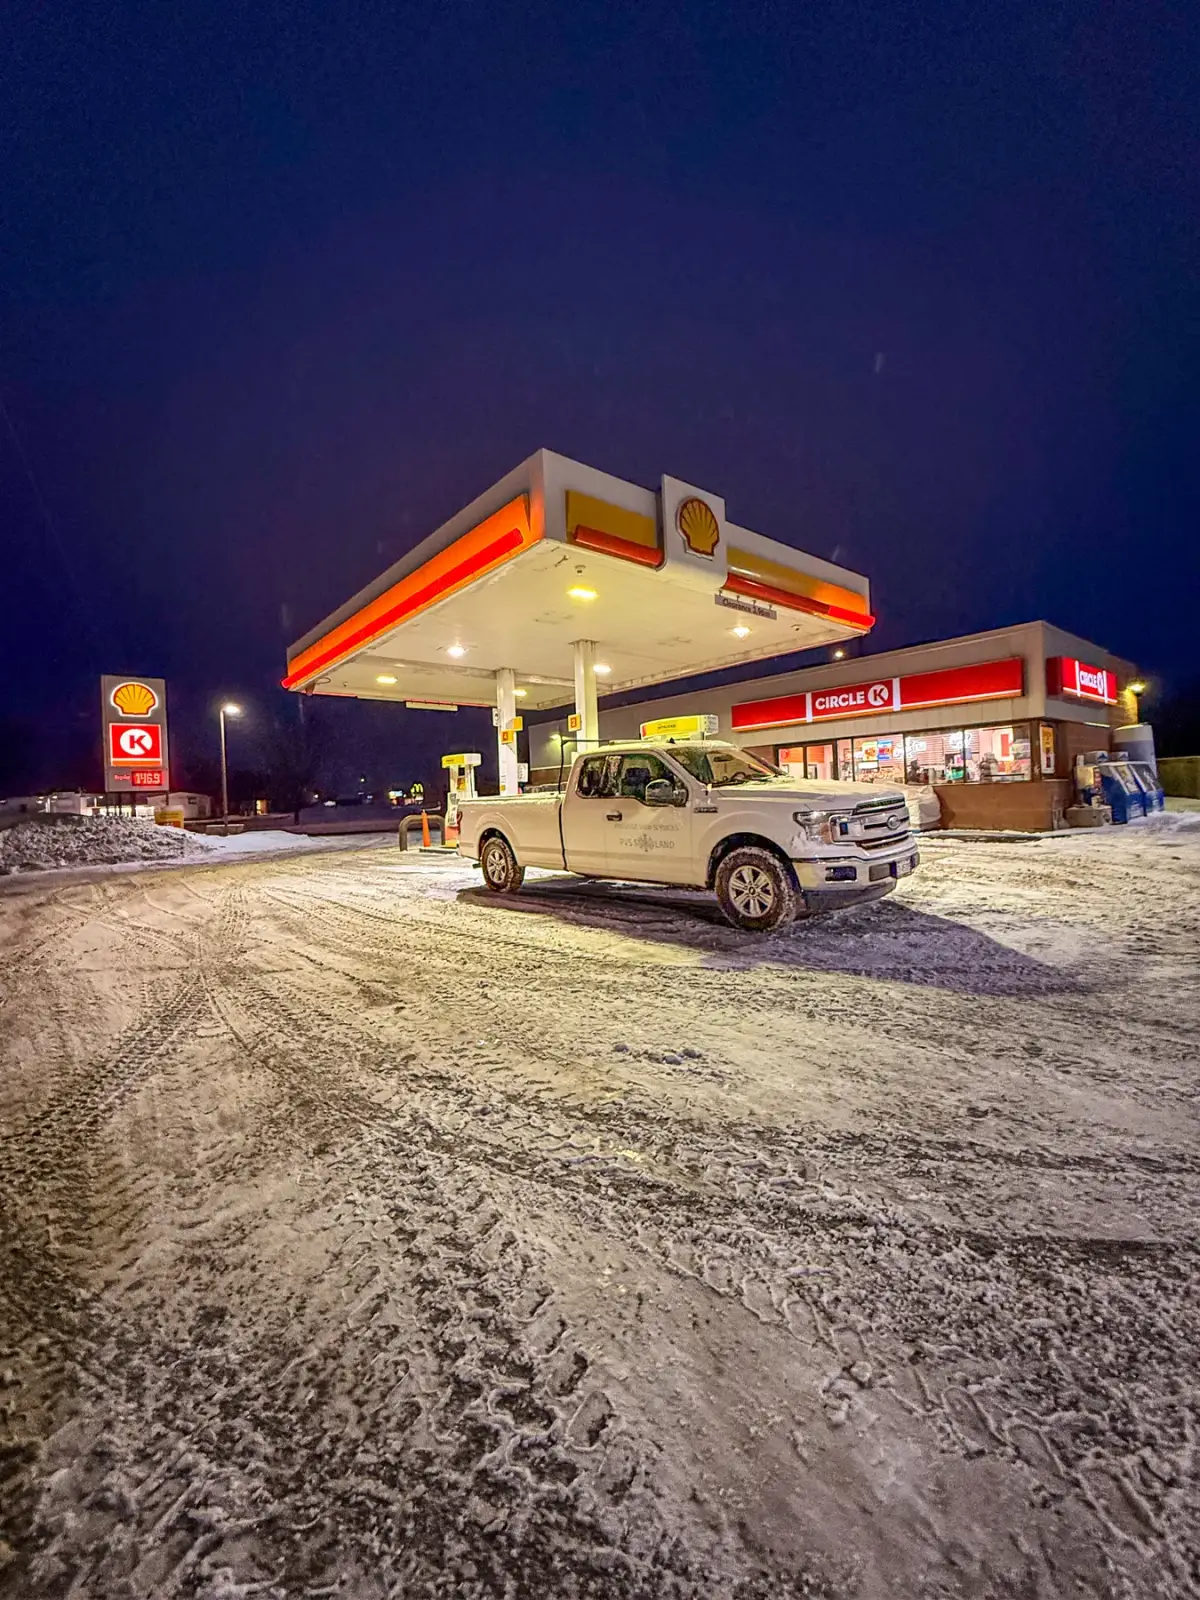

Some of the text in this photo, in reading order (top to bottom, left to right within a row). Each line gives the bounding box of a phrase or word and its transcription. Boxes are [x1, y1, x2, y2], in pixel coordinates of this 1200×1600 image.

[815, 686, 888, 710] CIRCLE K
[127, 734, 150, 753] K
